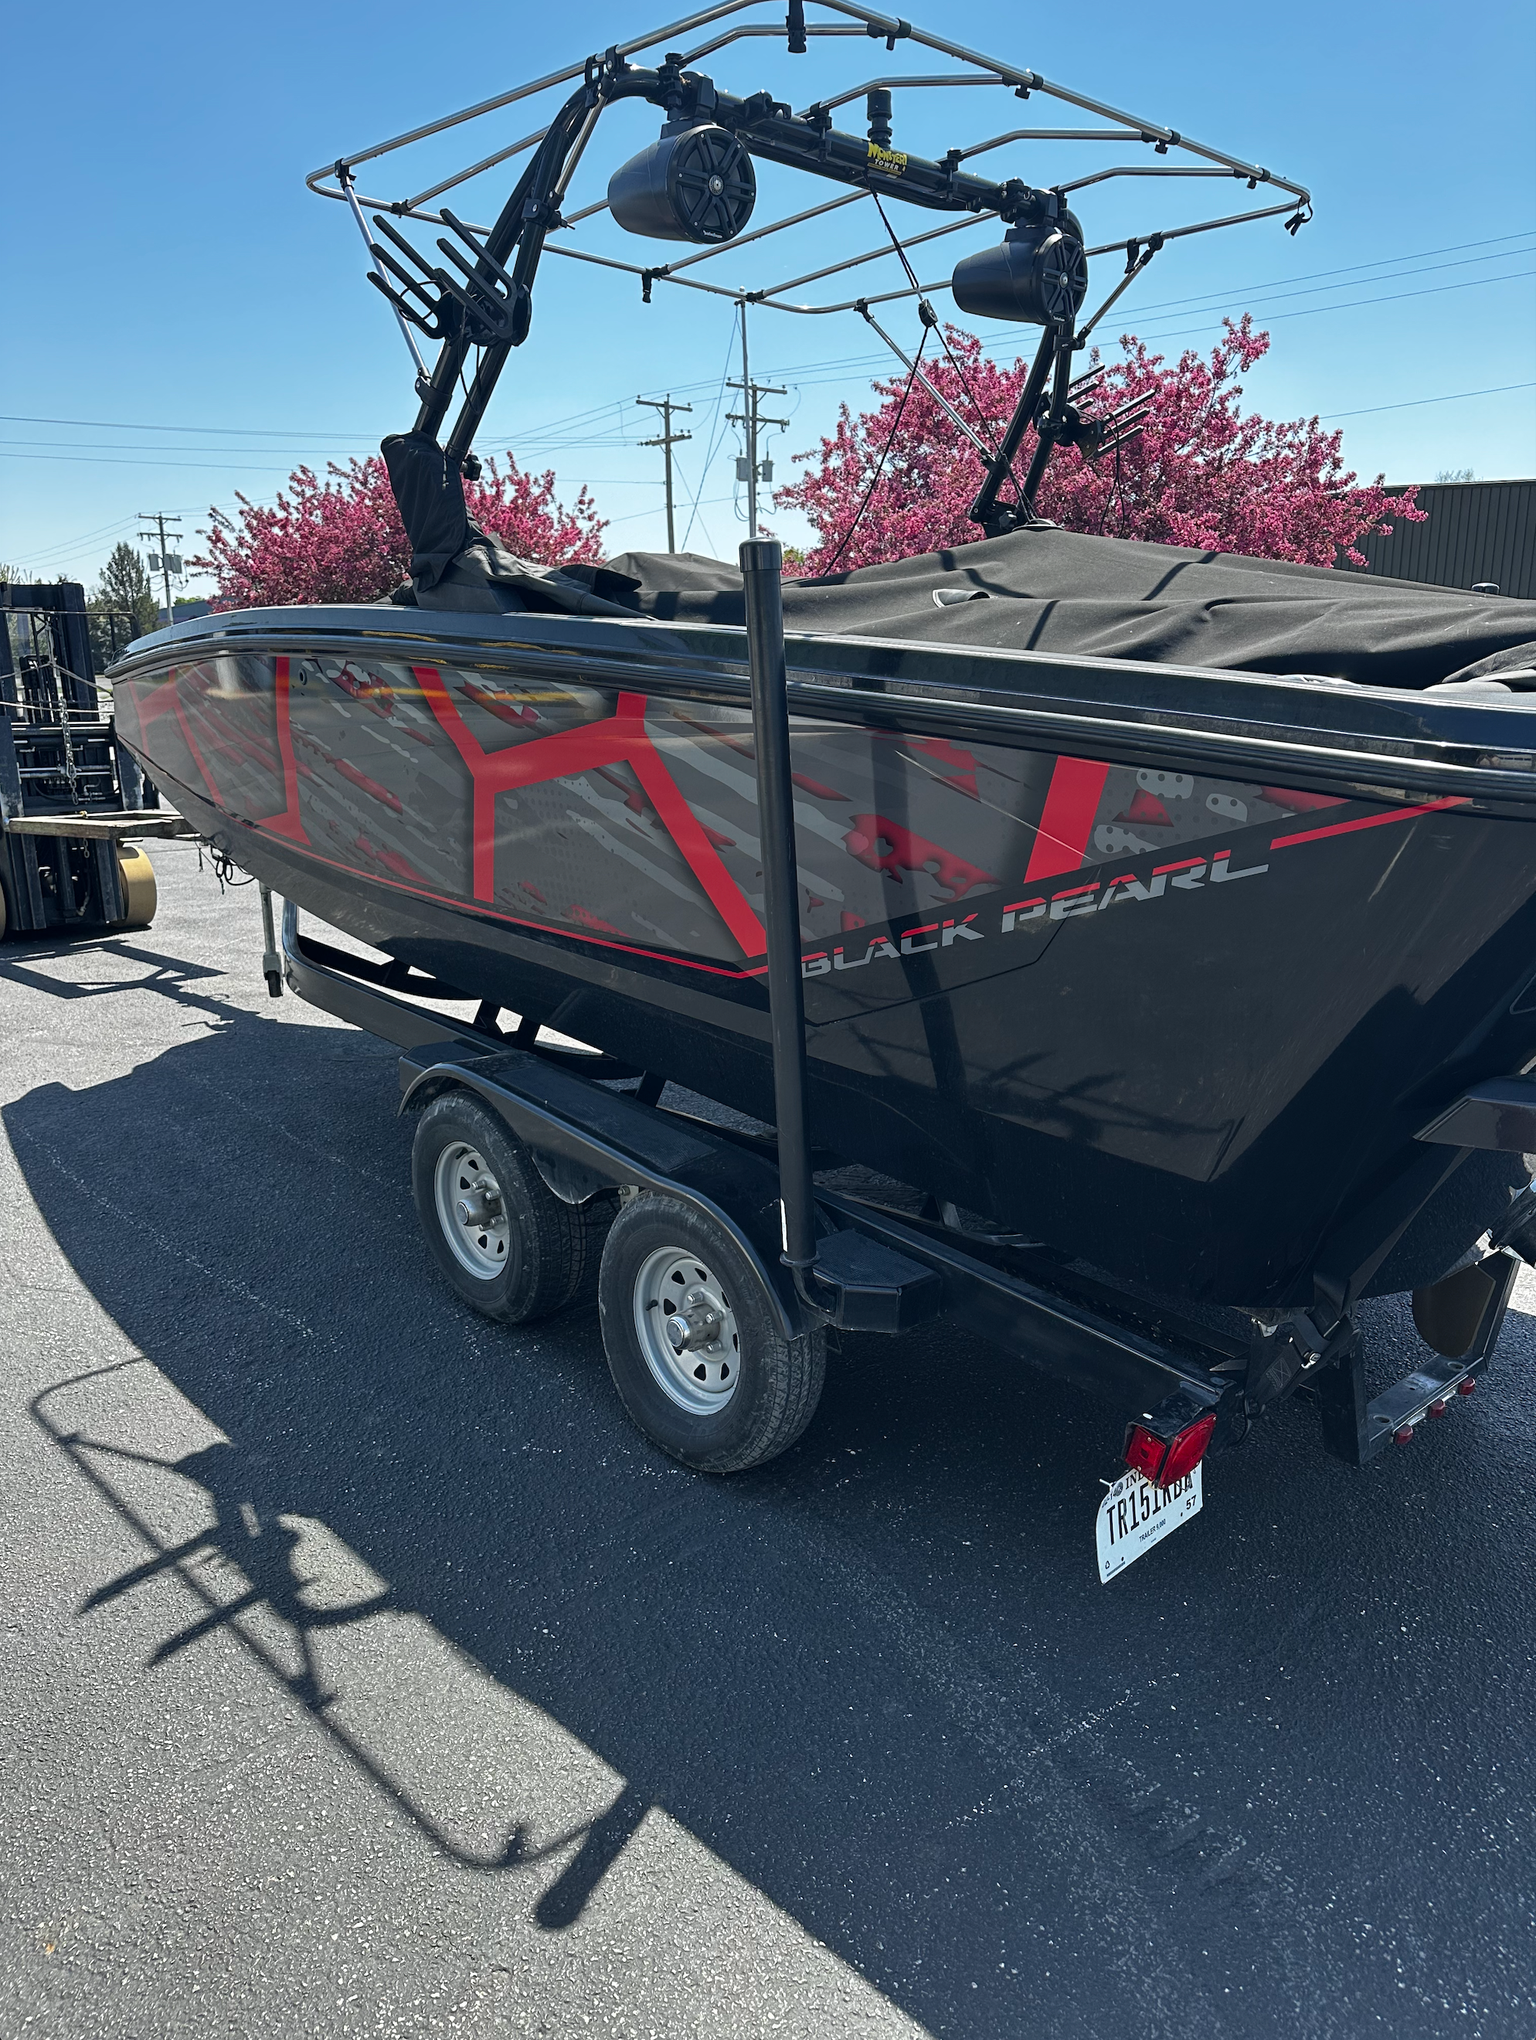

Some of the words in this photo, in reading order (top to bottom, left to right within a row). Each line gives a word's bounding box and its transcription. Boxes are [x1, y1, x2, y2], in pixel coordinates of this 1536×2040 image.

[874, 158, 899, 171] TOWER
[801, 912, 985, 979] BLACK
[1001, 849, 1269, 934] PEARL
[1185, 1494, 1197, 1511] 57
[1138, 1525, 1156, 1542] TRAILER
